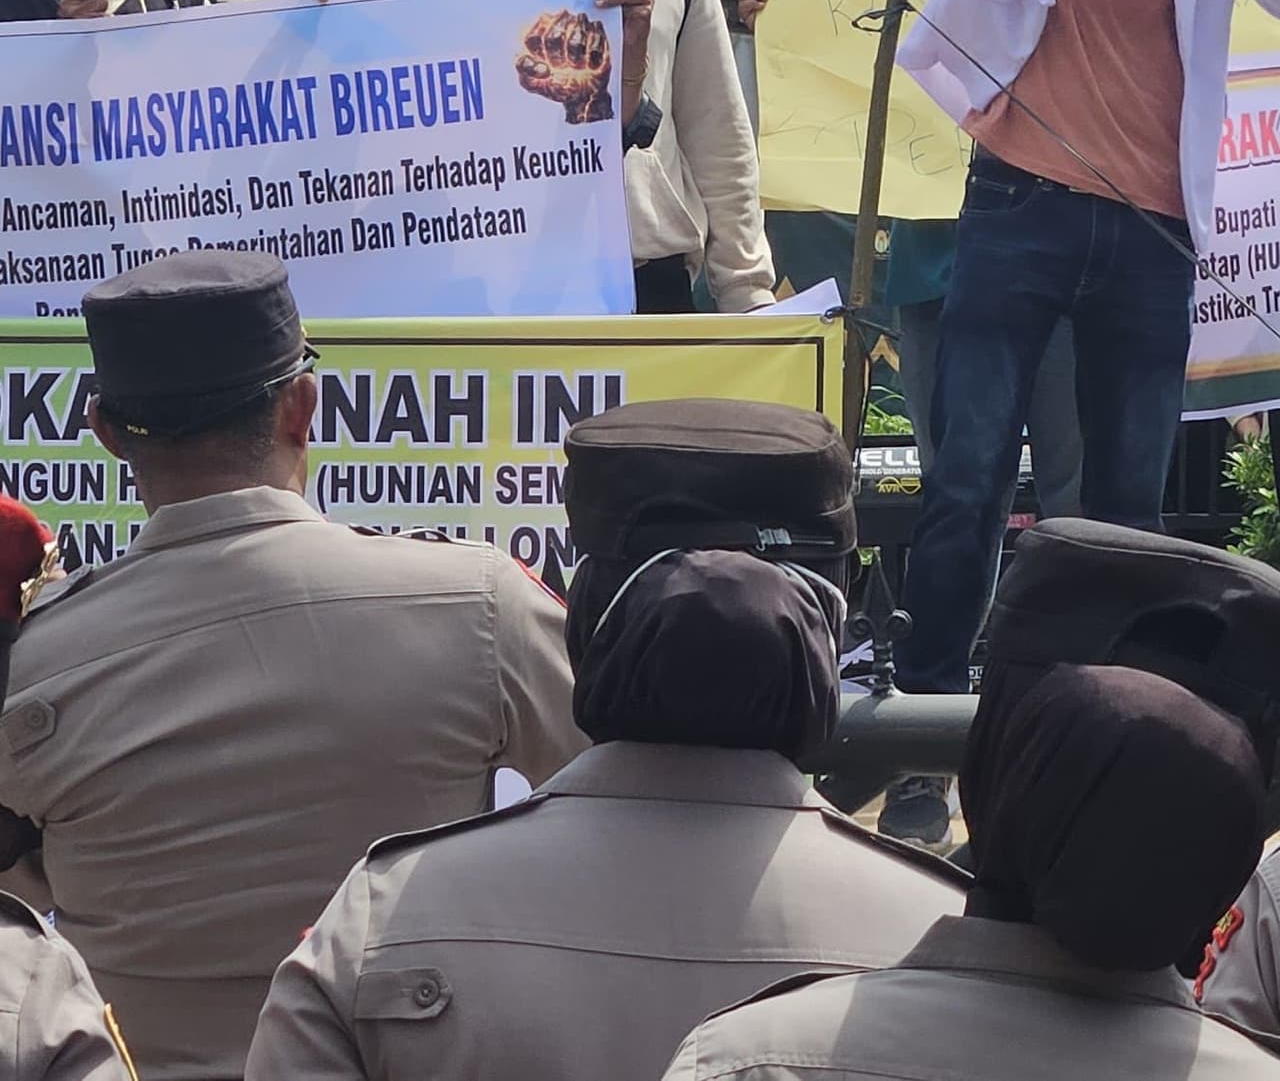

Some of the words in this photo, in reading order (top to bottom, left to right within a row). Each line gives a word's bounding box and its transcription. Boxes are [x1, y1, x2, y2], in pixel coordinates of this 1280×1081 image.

[92, 76, 320, 163] MASYARAKAT
[331, 58, 485, 136] BIREUEN
[2, 197, 116, 233] Ancaman,
[122, 183, 243, 223] Intimidasi,
[249, 176, 294, 211] Dan
[299, 165, 394, 206] Tekanan
[401, 153, 506, 197] Terhadap
[513, 139, 604, 181] Keuchik
[352, 216, 395, 253] Dan
[403, 205, 527, 248] Pendataan
[1215, 199, 1275, 235] Bupati
[308, 375, 485, 444] NAH
[317, 464, 481, 514] (HUNIAN
